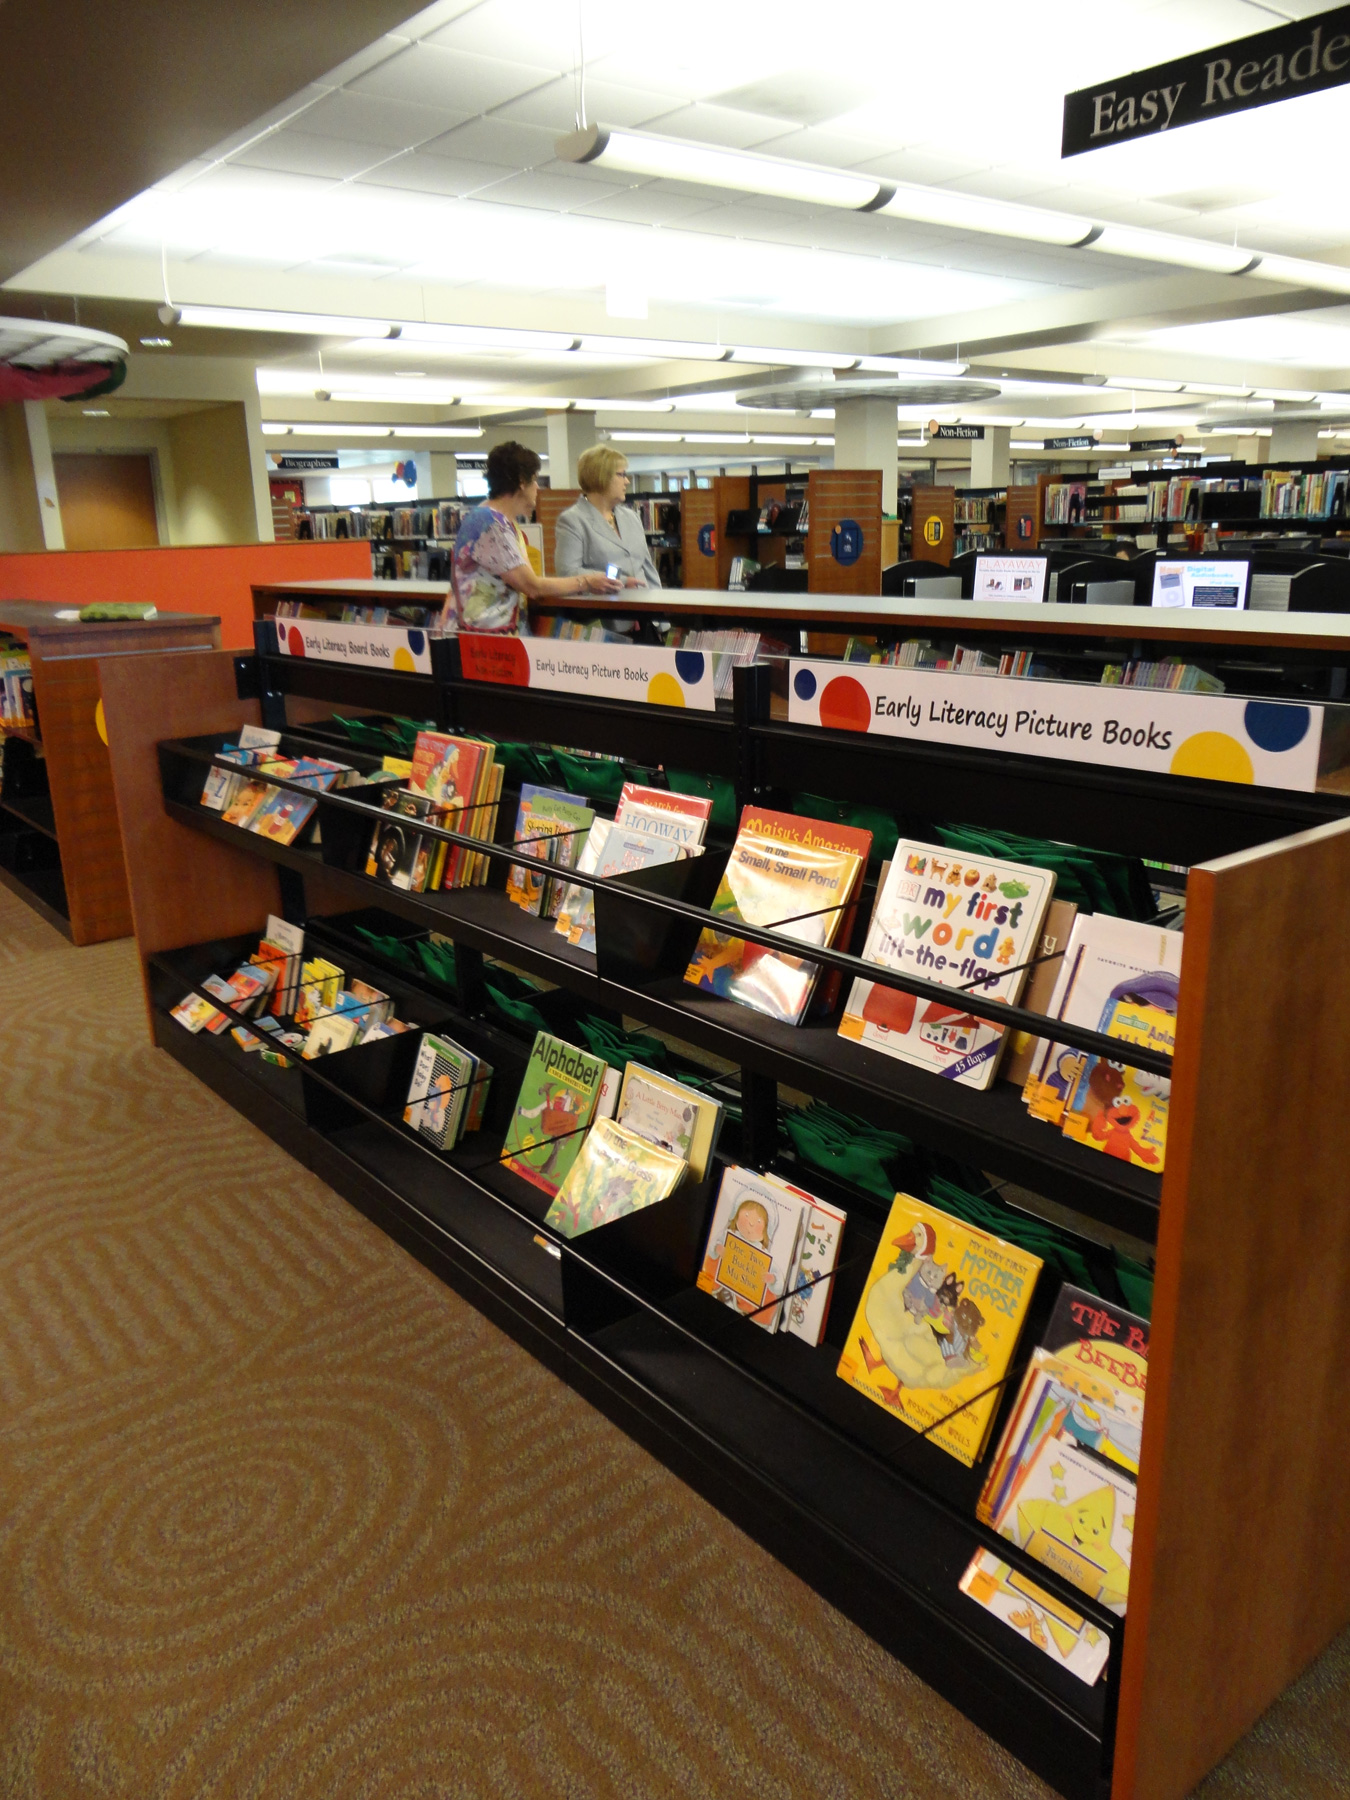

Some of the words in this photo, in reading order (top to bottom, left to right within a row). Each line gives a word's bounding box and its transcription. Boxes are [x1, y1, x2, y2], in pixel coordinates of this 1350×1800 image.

[1090, 82, 1187, 139] Easy
[1201, 25, 1350, 107] Reade
[940, 427, 978, 438] Non-Fiction
[1052, 438, 1089, 448] Non-Fiction
[285, 458, 332, 469] Biographies
[978, 559, 1042, 569] PLAYAWAY
[1186, 565, 1216, 573] Digital
[305, 635, 321, 654] Early
[322, 637, 347, 657] Literacy
[348, 641, 369, 655] Board
[370, 642, 390, 658] Books
[536, 659, 556, 676] Early
[558, 661, 590, 680] Literacy
[592, 664, 621, 680] Picture
[624, 667, 649, 682] Books
[875, 695, 921, 727] Early
[928, 701, 1008, 738] Literacy
[1014, 710, 1093, 741] Picture
[1102, 720, 1173, 751] Books
[775, 846, 790, 859] the
[738, 851, 771, 872] Small,
[773, 862, 808, 881] Small
[808, 869, 840, 890] Pond
[923, 887, 963, 919] my
[966, 891, 1023, 929] first
[903, 912, 1000, 960] word
[879, 933, 1000, 991] lift-the-flap
[532, 1035, 599, 1088] Alphabet
[932, 1054, 947, 1064] open
[954, 1060, 966, 1074] 45
[966, 1050, 987, 1068] flaps
[613, 1135, 629, 1150] the
[729, 1240, 746, 1258] One,
[749, 1250, 766, 1270] Two,
[732, 1255, 757, 1278] Buckle
[968, 1239, 983, 1252] MY
[983, 1247, 1005, 1264] VERY
[1005, 1258, 1029, 1277] FIRST
[727, 1265, 739, 1281] My
[740, 1273, 759, 1292] Shoe
[960, 1249, 1025, 1299] MOTHER
[968, 1277, 1018, 1320] GOOSE
[1070, 1301, 1121, 1338] THE
[907, 1397, 944, 1430] ROSEMAY
[948, 1426, 971, 1448] WELLS
[1045, 1545, 1085, 1581] Twinkle,
